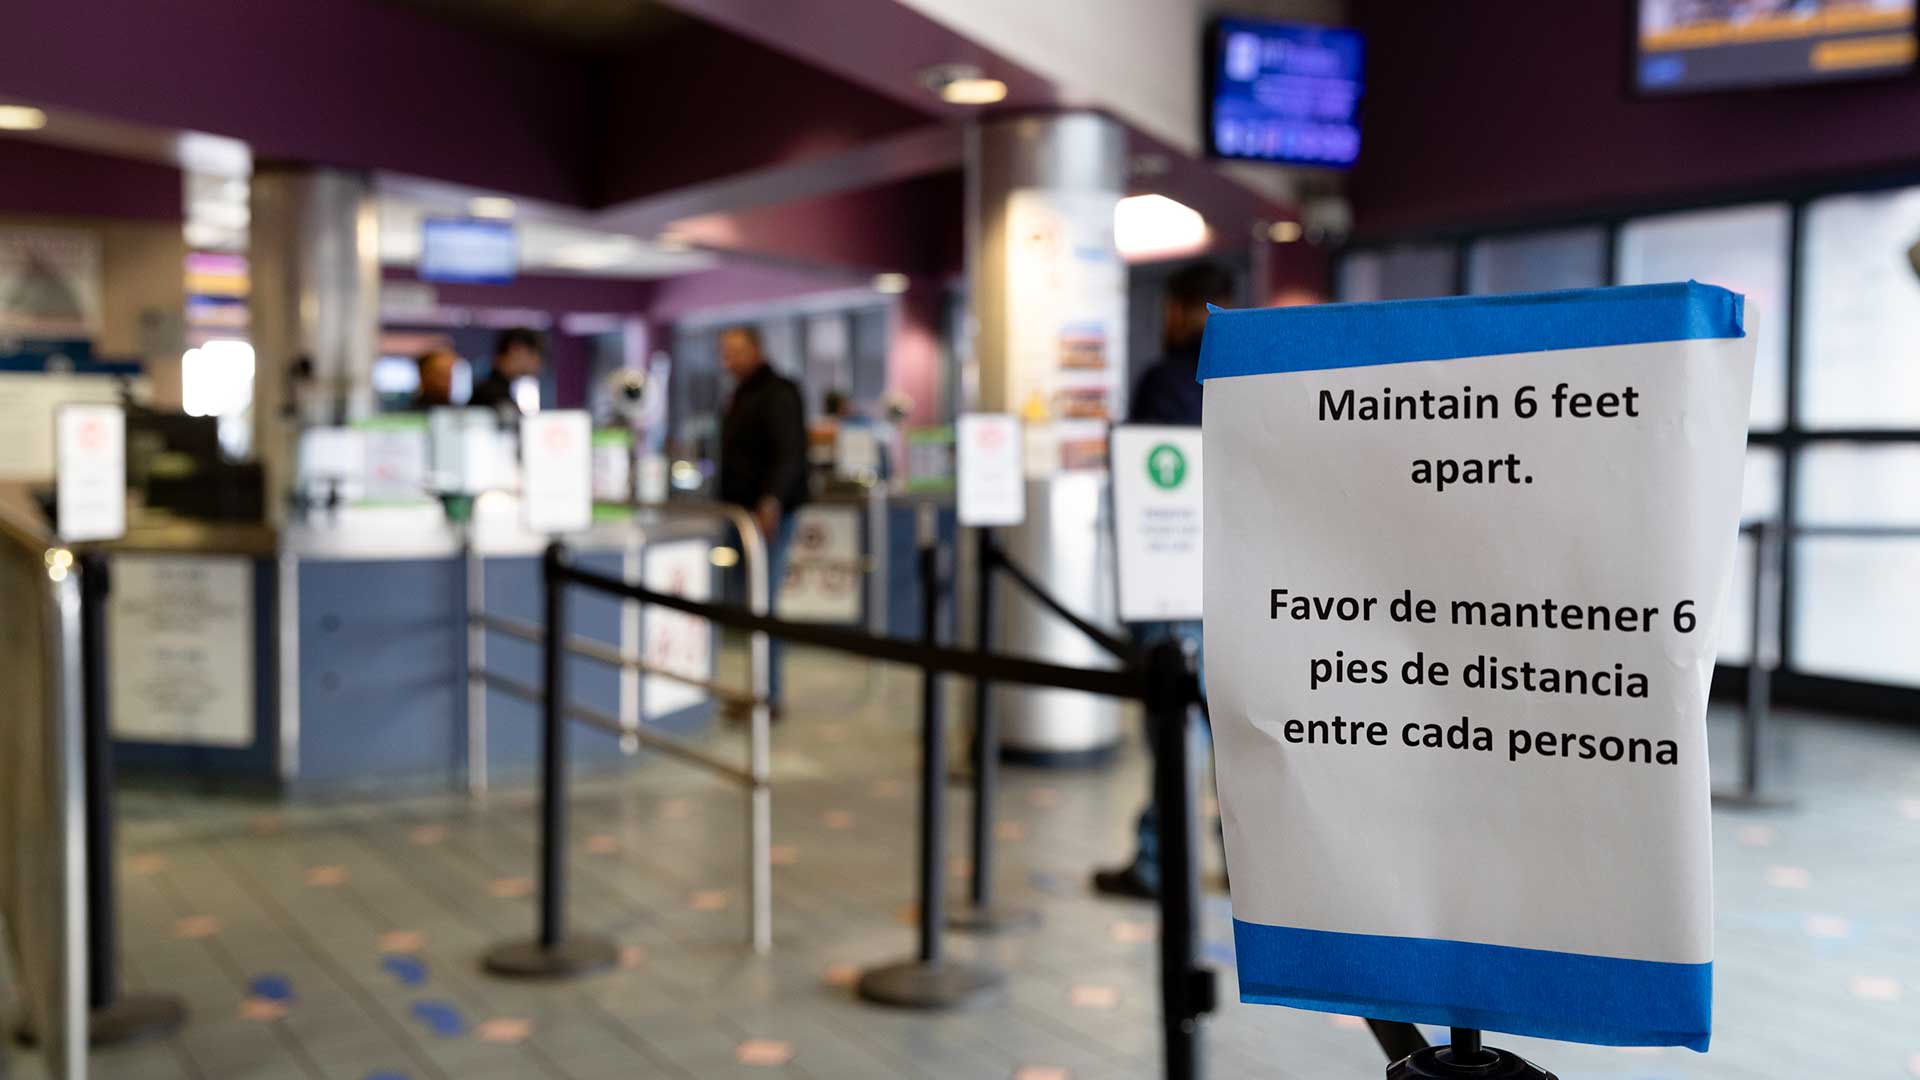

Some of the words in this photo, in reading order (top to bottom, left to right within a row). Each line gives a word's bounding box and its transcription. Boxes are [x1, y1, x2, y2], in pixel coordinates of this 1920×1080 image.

[1318, 386, 1499, 421] Maintain
[1514, 385, 1539, 419] 6
[1551, 382, 1639, 418] feet
[1411, 454, 1533, 493] apart.
[1270, 588, 1378, 622] Favor
[1389, 589, 1437, 624] de
[1451, 598, 1659, 633] mantener
[1673, 599, 1696, 634] 6
[1310, 650, 1388, 691] pies
[1401, 651, 1450, 687] de
[1462, 654, 1650, 699] distancia
[1283, 715, 1388, 747] entre
[1401, 716, 1493, 752] cada
[1508, 729, 1679, 766] persona
